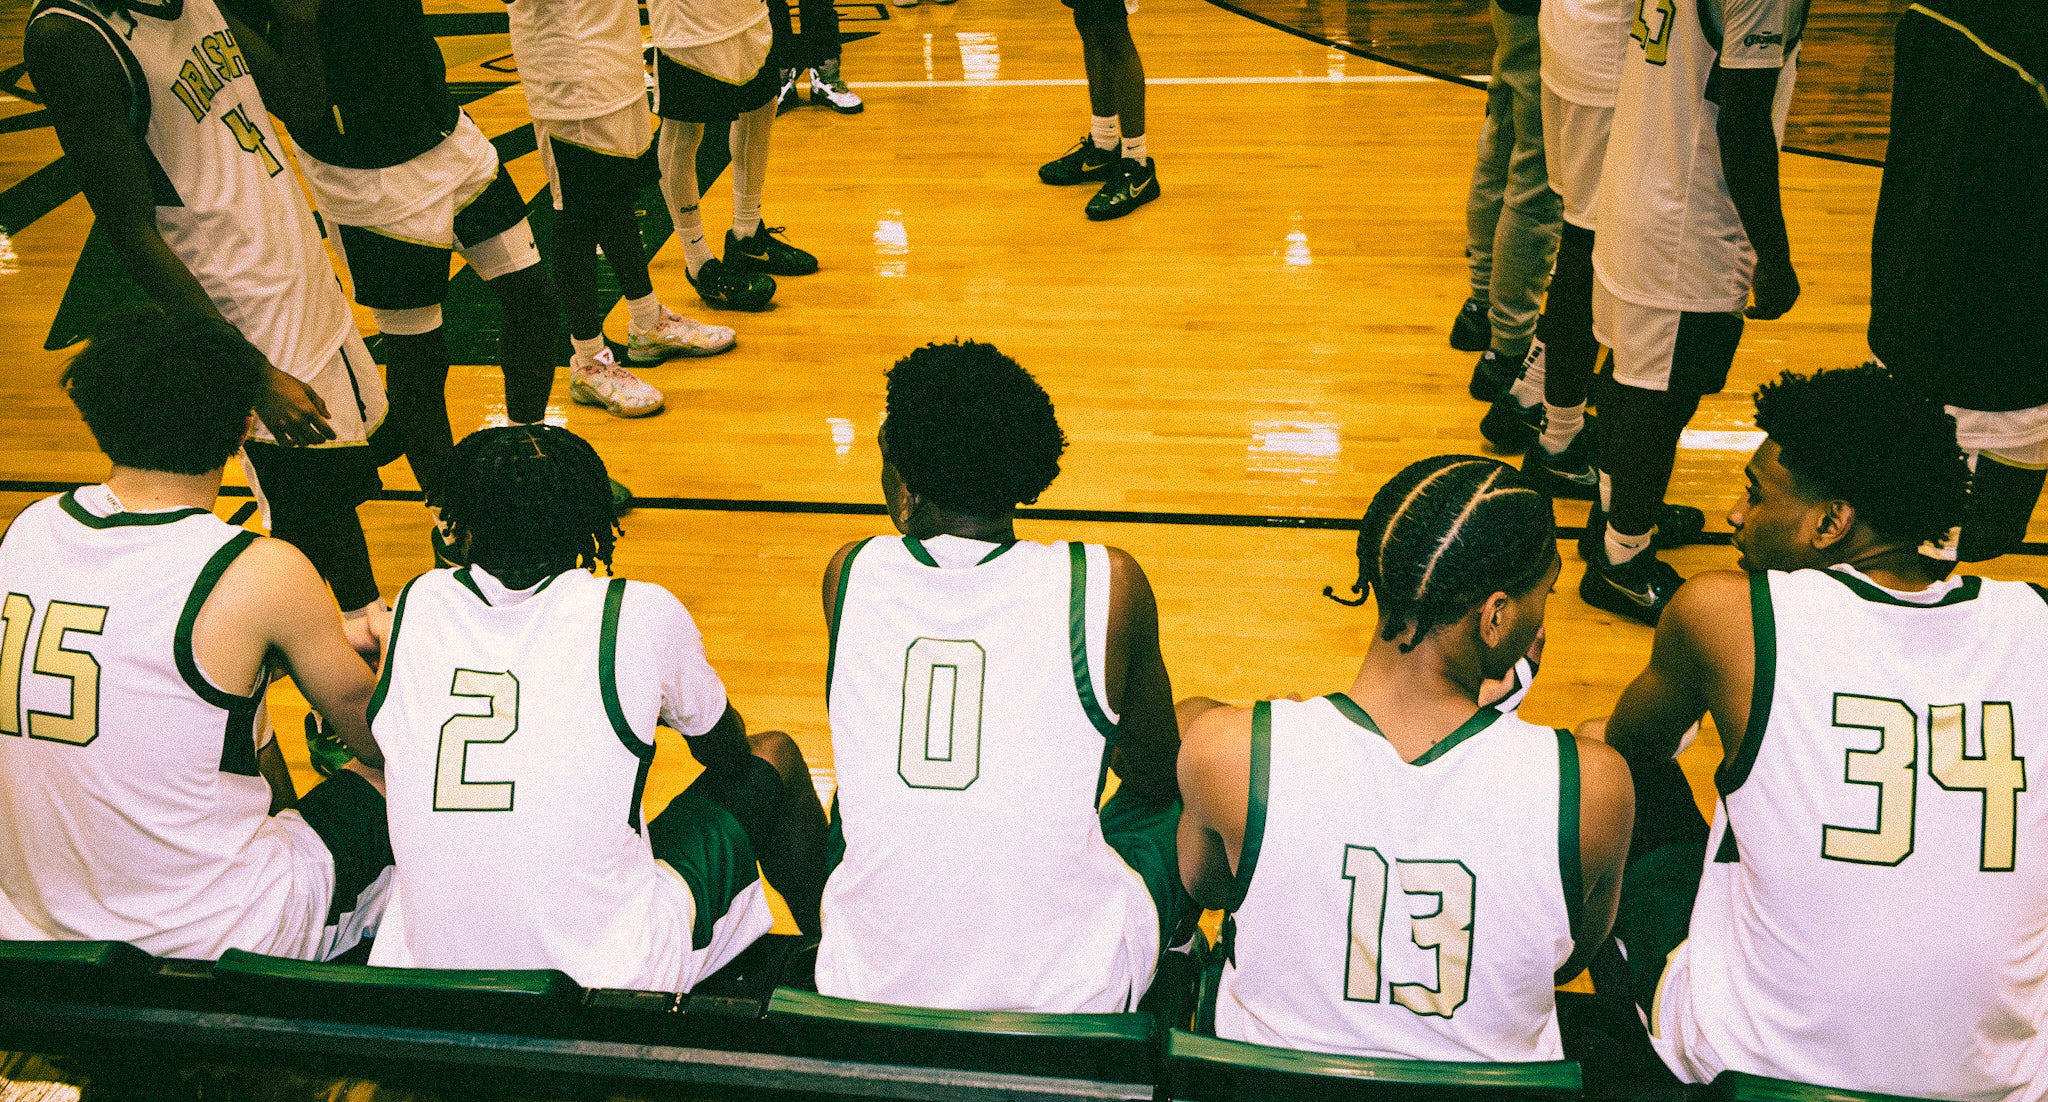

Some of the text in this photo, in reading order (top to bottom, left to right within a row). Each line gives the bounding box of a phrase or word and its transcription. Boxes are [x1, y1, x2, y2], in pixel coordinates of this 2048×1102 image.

[170, 28, 251, 124] IRISH
[220, 102, 284, 179] 4
[0, 591, 110, 747] 15
[433, 668, 520, 812] 2
[897, 637, 986, 791] 0
[1821, 692, 2027, 872] 34
[1342, 843, 1477, 1019] 13
